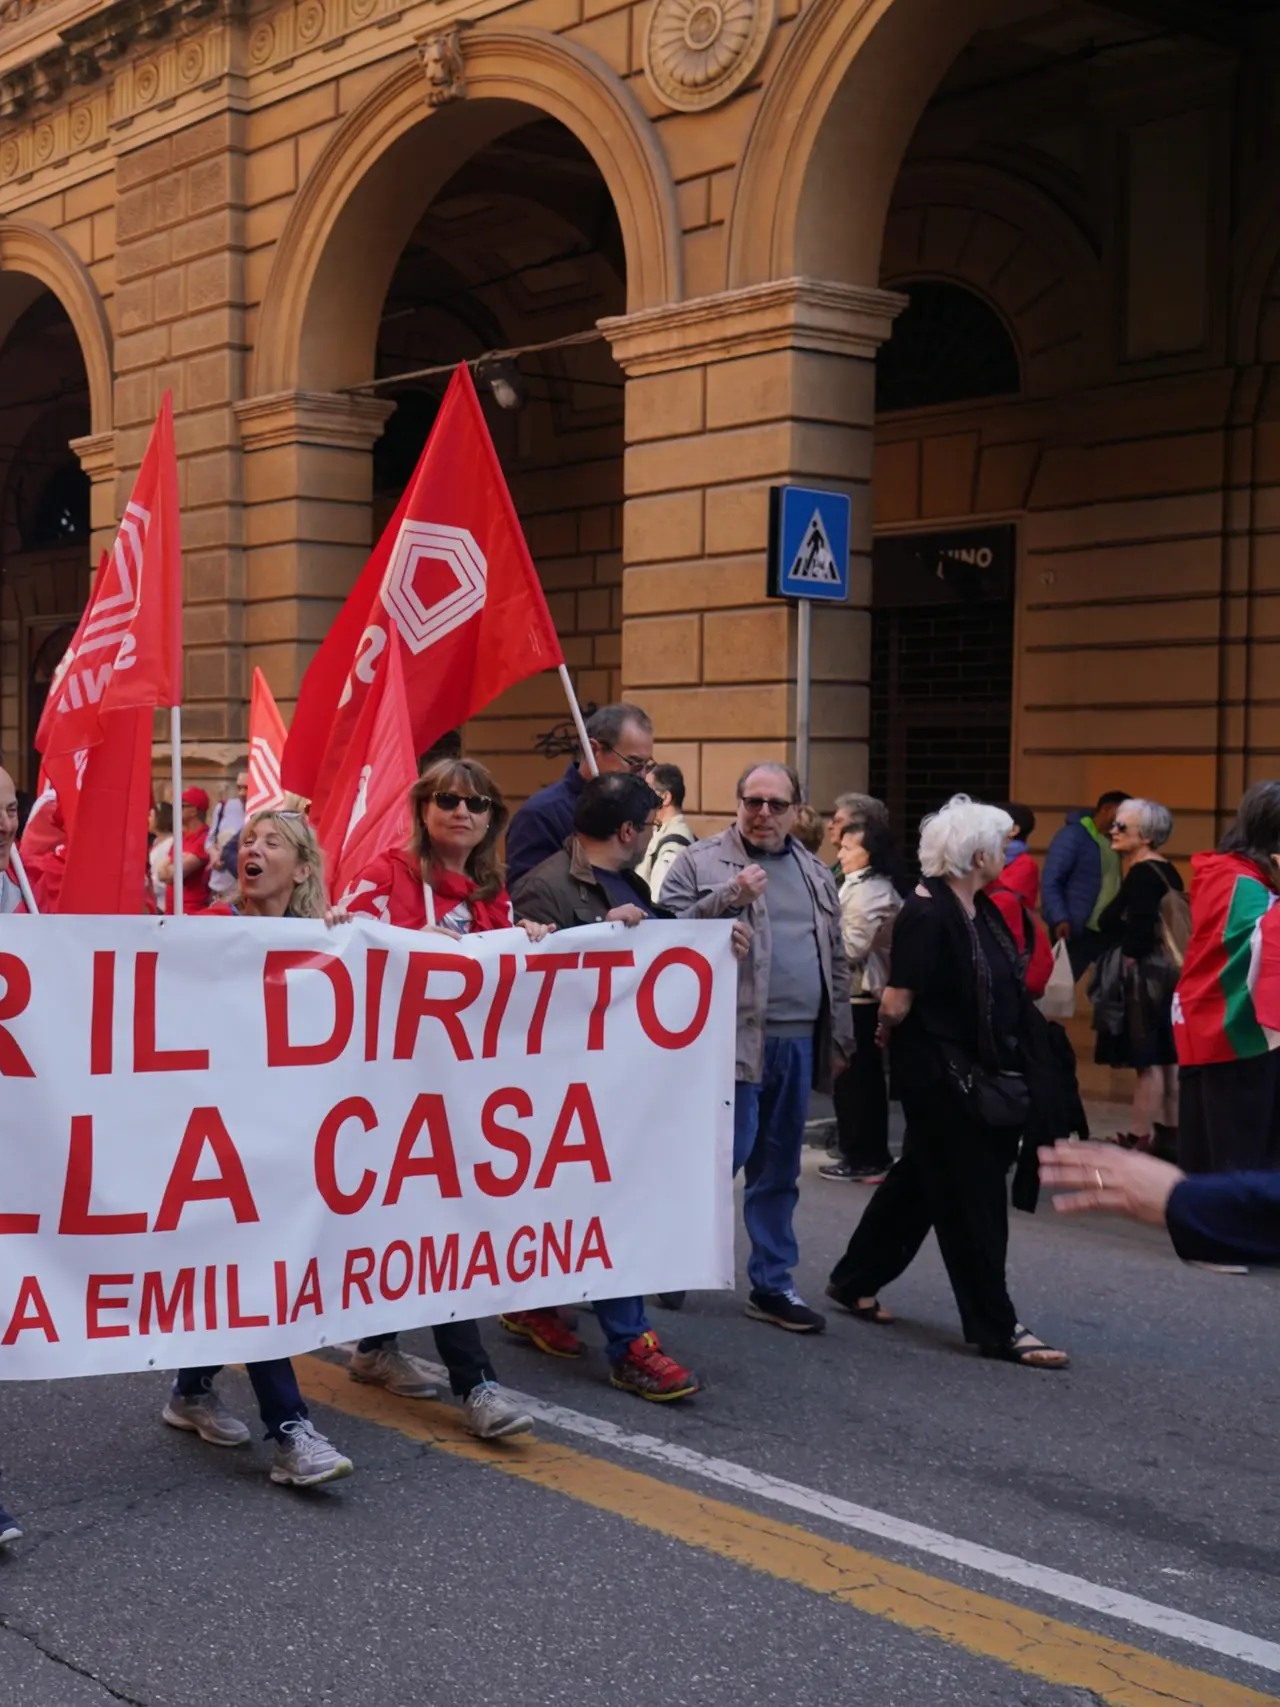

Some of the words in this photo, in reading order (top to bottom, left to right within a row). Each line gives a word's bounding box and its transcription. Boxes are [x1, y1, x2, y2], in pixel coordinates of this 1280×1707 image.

[90, 950, 210, 1075] IL
[263, 946, 713, 1067] DIRITTO
[314, 1082, 612, 1215] CASA
[86, 1258, 323, 1340] EMILIA
[342, 1216, 613, 1310] ROMAGNA
